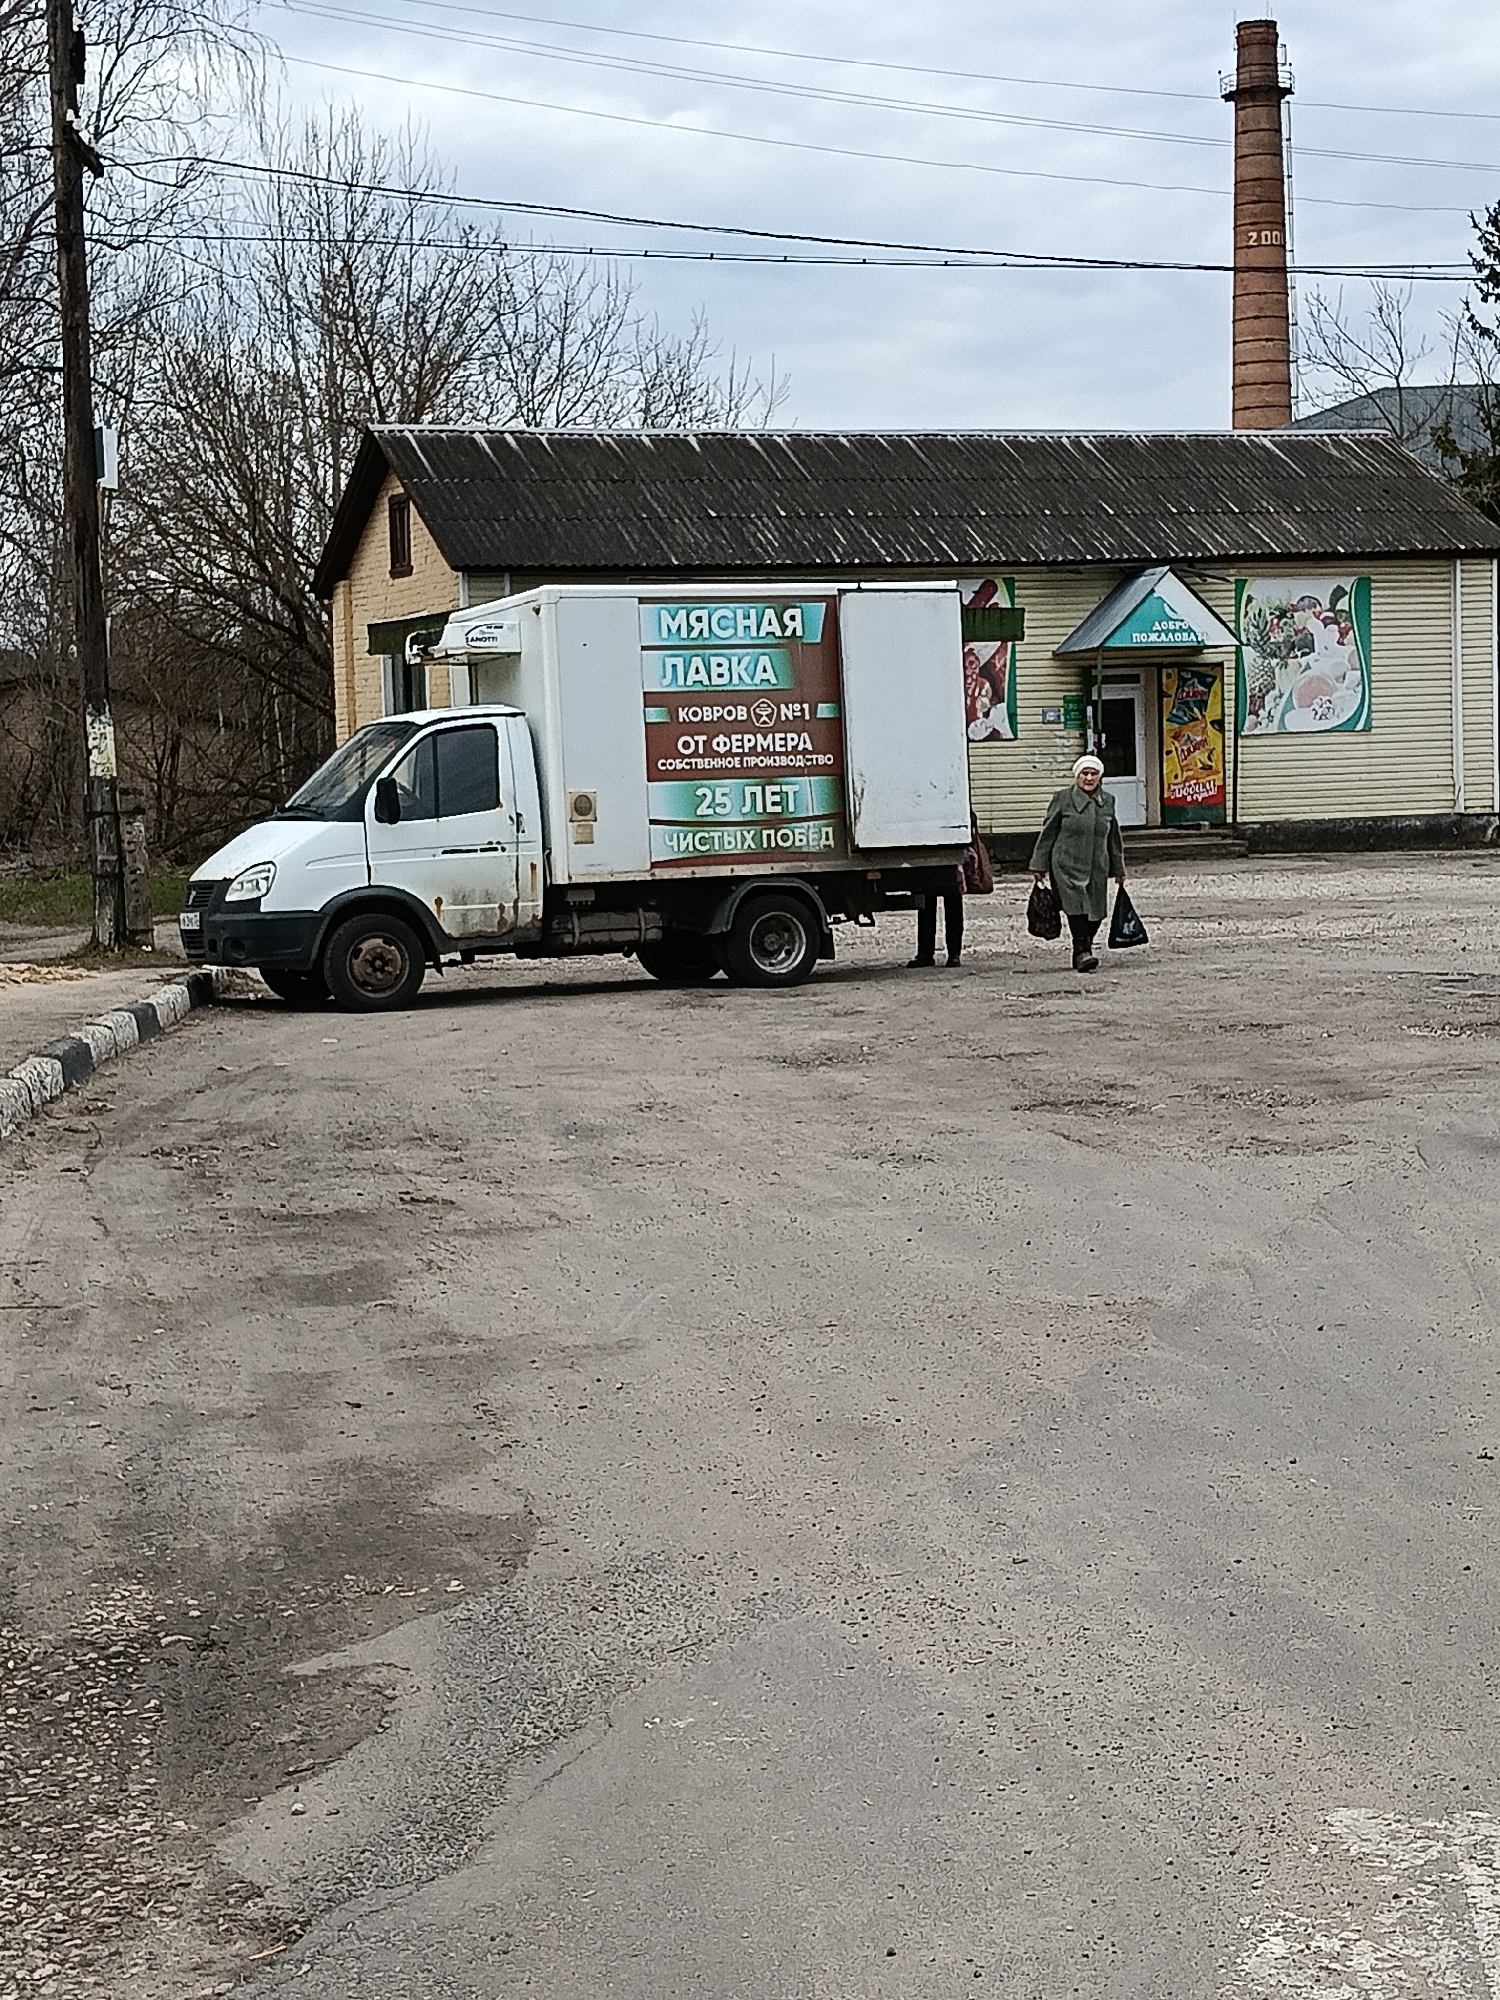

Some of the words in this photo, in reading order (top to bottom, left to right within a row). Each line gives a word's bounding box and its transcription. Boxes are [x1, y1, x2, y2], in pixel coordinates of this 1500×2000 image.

[659, 608, 804, 640] МЯСНАЯ
[662, 655, 778, 687] ЛАВКА
[678, 705, 748, 723] КОВРОВ
[780, 703, 811, 721] №1
[677, 735, 707, 755] ОТ
[711, 733, 813, 755] ФЕРМЕРА
[657, 758, 741, 771] СОБСТВЕННОЕ
[743, 754, 834, 768] ПРОИЗВОДСТВО
[694, 787, 733, 817] 25
[740, 785, 800, 815] ЛЕТ
[664, 829, 757, 853] ЧИСТЫХ
[761, 826, 835, 850] ПОБЕД
